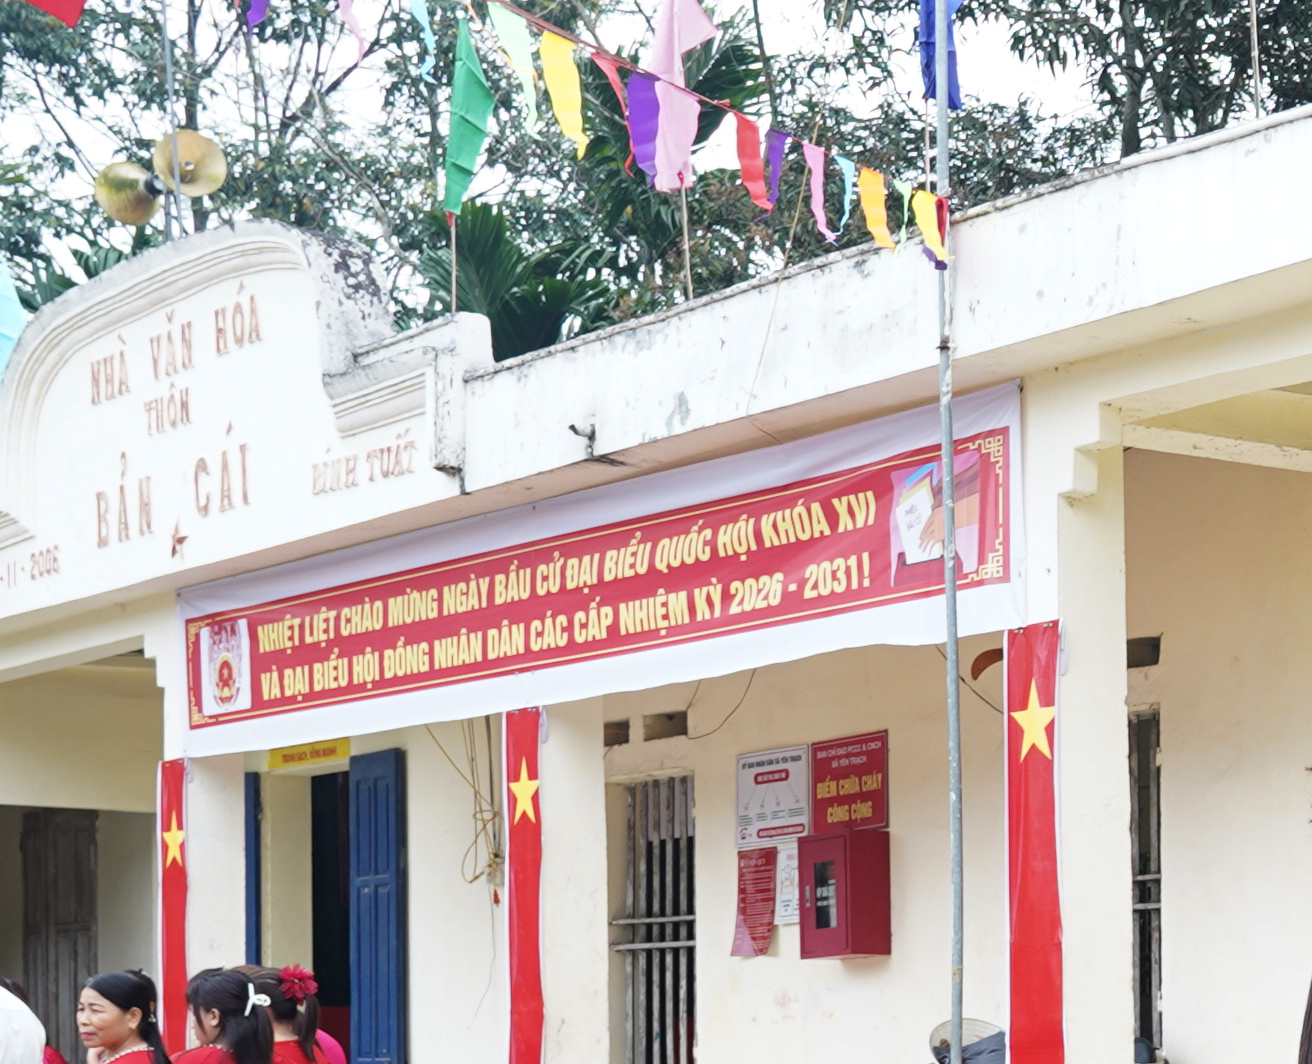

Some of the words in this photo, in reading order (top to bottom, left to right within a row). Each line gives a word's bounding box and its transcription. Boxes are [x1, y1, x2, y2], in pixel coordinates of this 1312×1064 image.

[91, 333, 131, 406] NHÀ
[149, 309, 195, 380] VĂN
[214, 279, 264, 356] HÓA
[143, 381, 192, 436] THÔN
[96, 451, 154, 548] BẢN
[193, 420, 251, 517] CÁI
[257, 614, 301, 654] NHIỆT
[304, 606, 337, 647] LIỆT
[340, 597, 384, 637] CHÀO
[387, 588, 438, 628] MỪNG
[443, 573, 490, 616] NGÀY
[494, 559, 531, 605] BẦU
[536, 551, 564, 596] CỬ
[565, 553, 600, 594] ĐẠI
[603, 531, 652, 582] BIỂU
[654, 519, 713, 574] QUỐC
[716, 513, 758, 561] HỘI
[760, 498, 831, 548] KHÓA
[831, 490, 877, 533] XVI
[260, 665, 281, 701] VÀ
[283, 665, 310, 701] ĐẠI
[313, 647, 349, 692] BIỂU
[352, 646, 380, 689] HỘI
[383, 636, 430, 679] ĐỒNG
[434, 627, 483, 670] NHÂN
[487, 619, 525, 660] DÂN
[529, 610, 569, 652] CÁC
[573, 595, 614, 643] CẤP
[619, 588, 690, 636] NHIỆM
[694, 577, 722, 622] KỲ
[728, 571, 784, 615] 2026
[787, 583, 798, 592] -
[803, 551, 871, 600] 2031!
[817, 775, 838, 799] ĐIỂM
[839, 775, 860, 796] CHỮA
[862, 770, 882, 792] CHÁY
[827, 803, 849, 823] CÔNG
[851, 800, 873, 823] CỘNG
